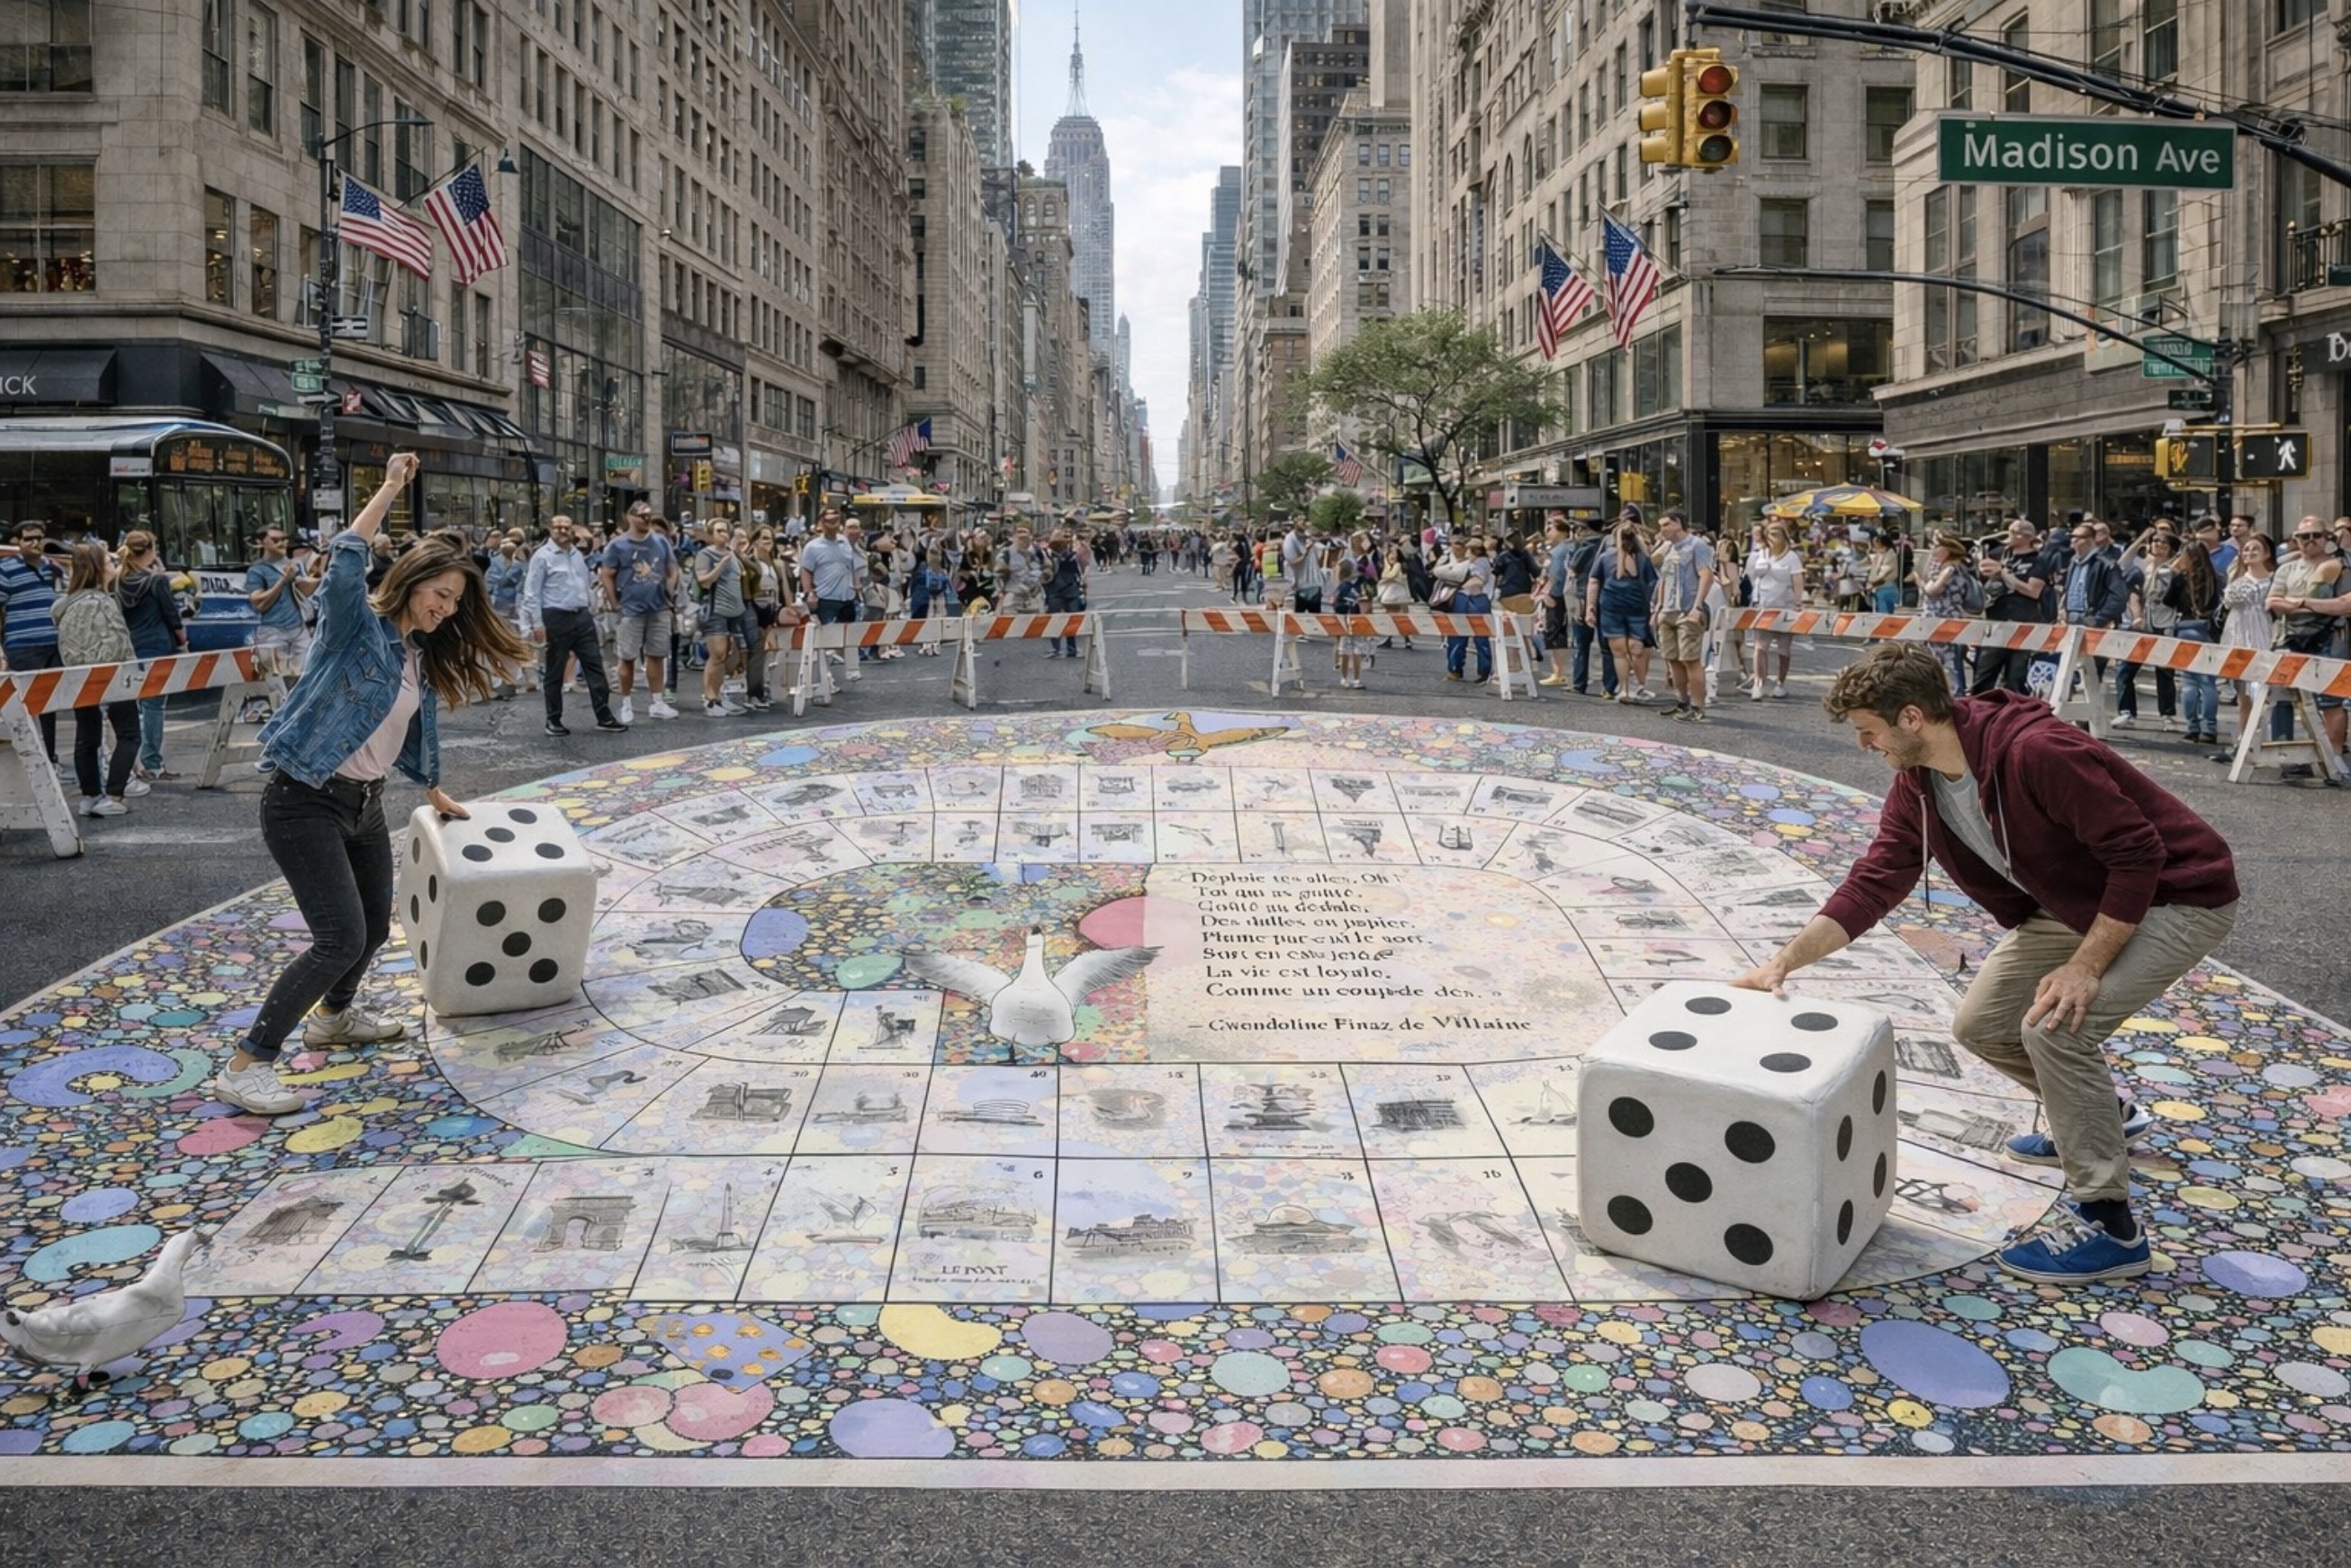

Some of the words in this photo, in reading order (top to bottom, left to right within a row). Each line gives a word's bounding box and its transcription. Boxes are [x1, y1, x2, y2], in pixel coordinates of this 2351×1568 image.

[1963, 132, 2139, 171] Madison
[2155, 140, 2221, 174] Ave
[1399, 1017, 1425, 1032] de
